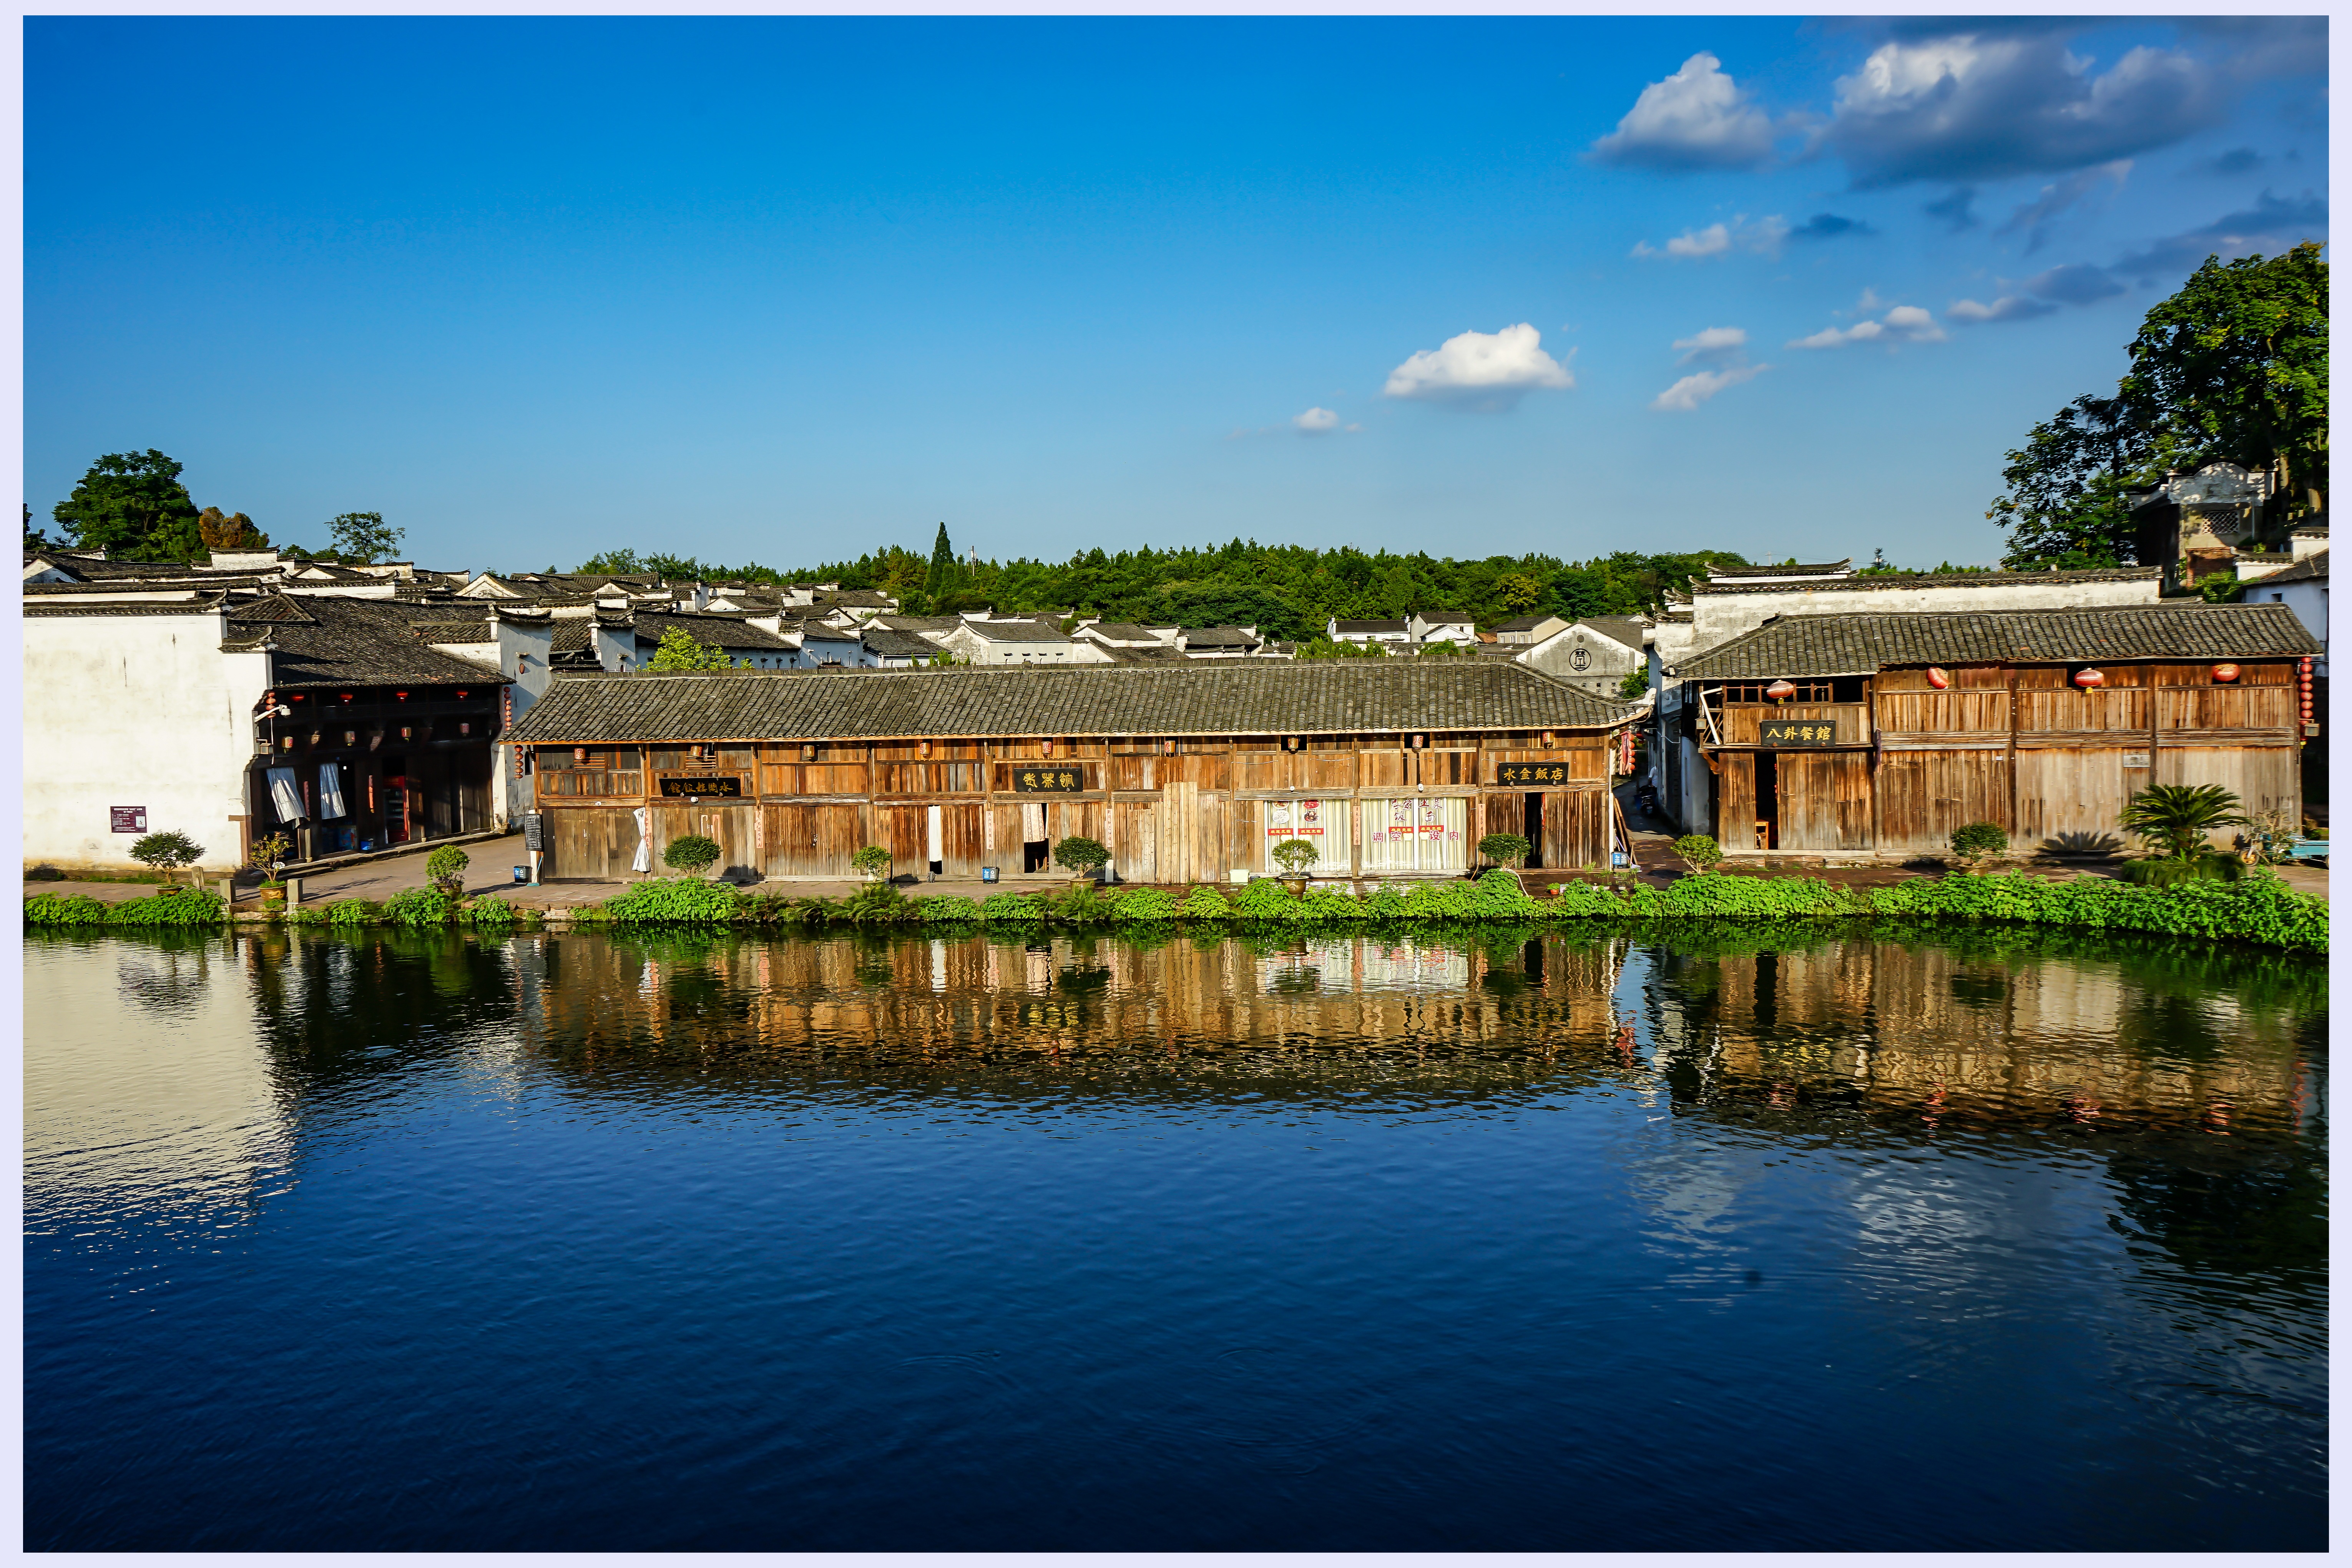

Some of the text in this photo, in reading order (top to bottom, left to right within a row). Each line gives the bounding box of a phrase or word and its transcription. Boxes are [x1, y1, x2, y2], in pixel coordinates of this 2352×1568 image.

[1766, 726, 1832, 741] 八卦餐館
[1503, 767, 1563, 781] 水金飯店
